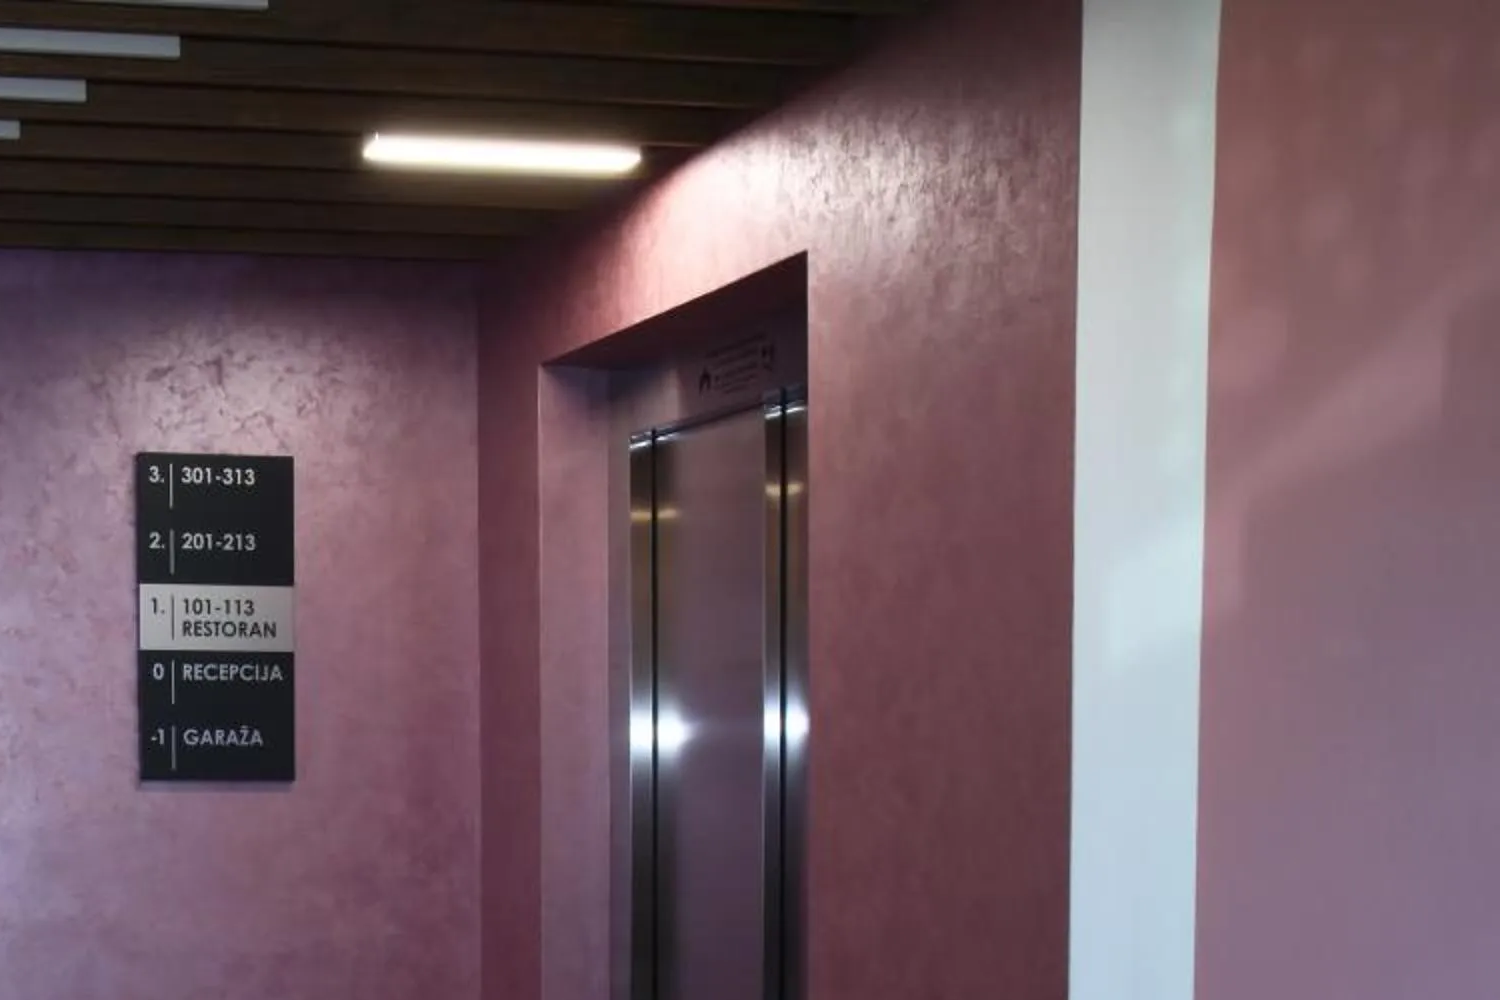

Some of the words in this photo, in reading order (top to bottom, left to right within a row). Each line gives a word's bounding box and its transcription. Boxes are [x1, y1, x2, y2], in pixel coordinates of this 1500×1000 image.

[149, 465, 165, 483] 3.
[181, 467, 256, 485] 301-313
[149, 532, 165, 549] 2.
[181, 533, 256, 551] 201-213
[152, 597, 165, 614] 1.
[183, 598, 255, 616] 101-113
[182, 620, 277, 638] RESTORAN
[183, 663, 283, 681] RECEPCIJA
[151, 728, 165, 745] -1
[183, 725, 263, 746] GARAŽA
